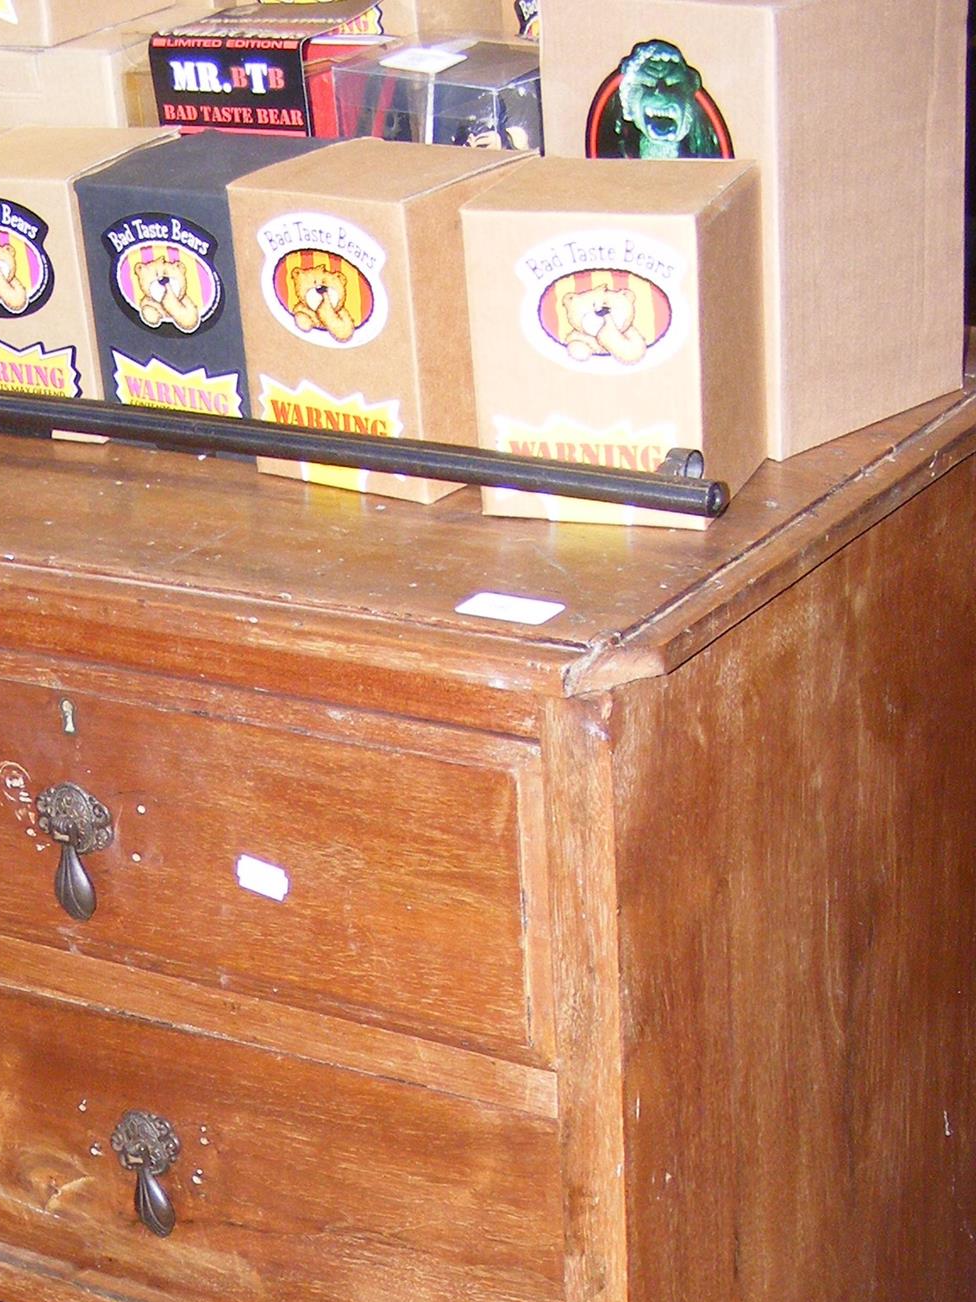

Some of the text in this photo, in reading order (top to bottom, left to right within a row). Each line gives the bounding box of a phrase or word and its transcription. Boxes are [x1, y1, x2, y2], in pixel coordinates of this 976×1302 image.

[166, 38, 283, 49] LIMITED EDITION
[163, 103, 304, 126] BAD TASTE BEAR
[1, 203, 39, 240] Bears
[107, 218, 210, 256] Bad Taste Bears
[264, 221, 377, 270] Bad Taste Bears
[526, 239, 675, 280] Bad Taste Bears
[124, 375, 230, 416] WARNING
[270, 399, 389, 438] WARNING
[508, 441, 662, 474] WARNING
